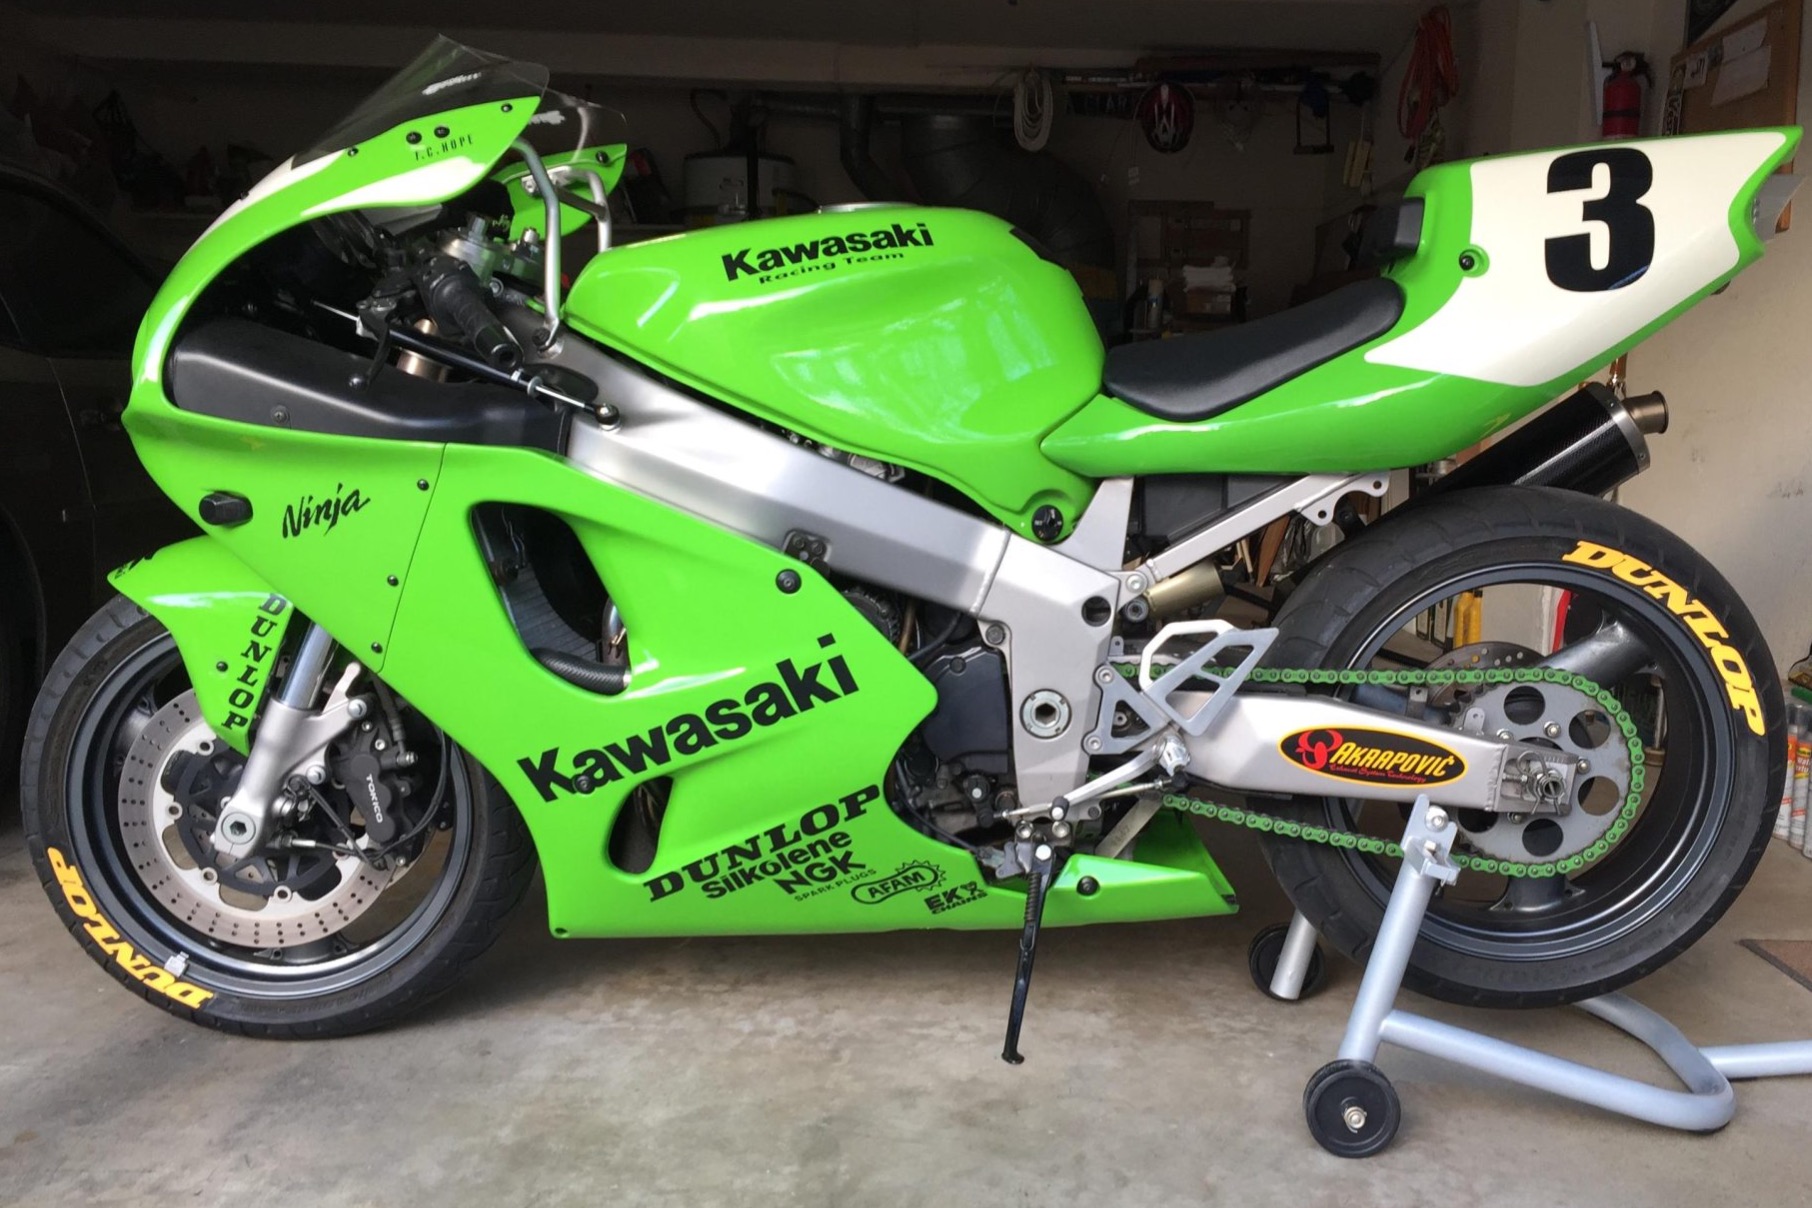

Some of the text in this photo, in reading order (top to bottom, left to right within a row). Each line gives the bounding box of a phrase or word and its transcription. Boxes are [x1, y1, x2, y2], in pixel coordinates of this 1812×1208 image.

[1545, 148, 1655, 292] 3
[721, 223, 934, 282] Kawasaki
[758, 252, 904, 285] Racing Team
[282, 482, 371, 539] Ninja
[220, 593, 288, 731] DUNLOP
[1561, 540, 1766, 736] DUNLOP
[516, 632, 860, 803] Kawasaki
[366, 773, 383, 823] TOKICO
[643, 784, 880, 902] DUNLOP
[701, 830, 853, 900] Silkolene
[772, 850, 867, 896] NGK
[794, 868, 877, 902] SPARK PLUGS
[867, 871, 926, 899] AFAM
[47, 847, 214, 1009] DUNLOP
